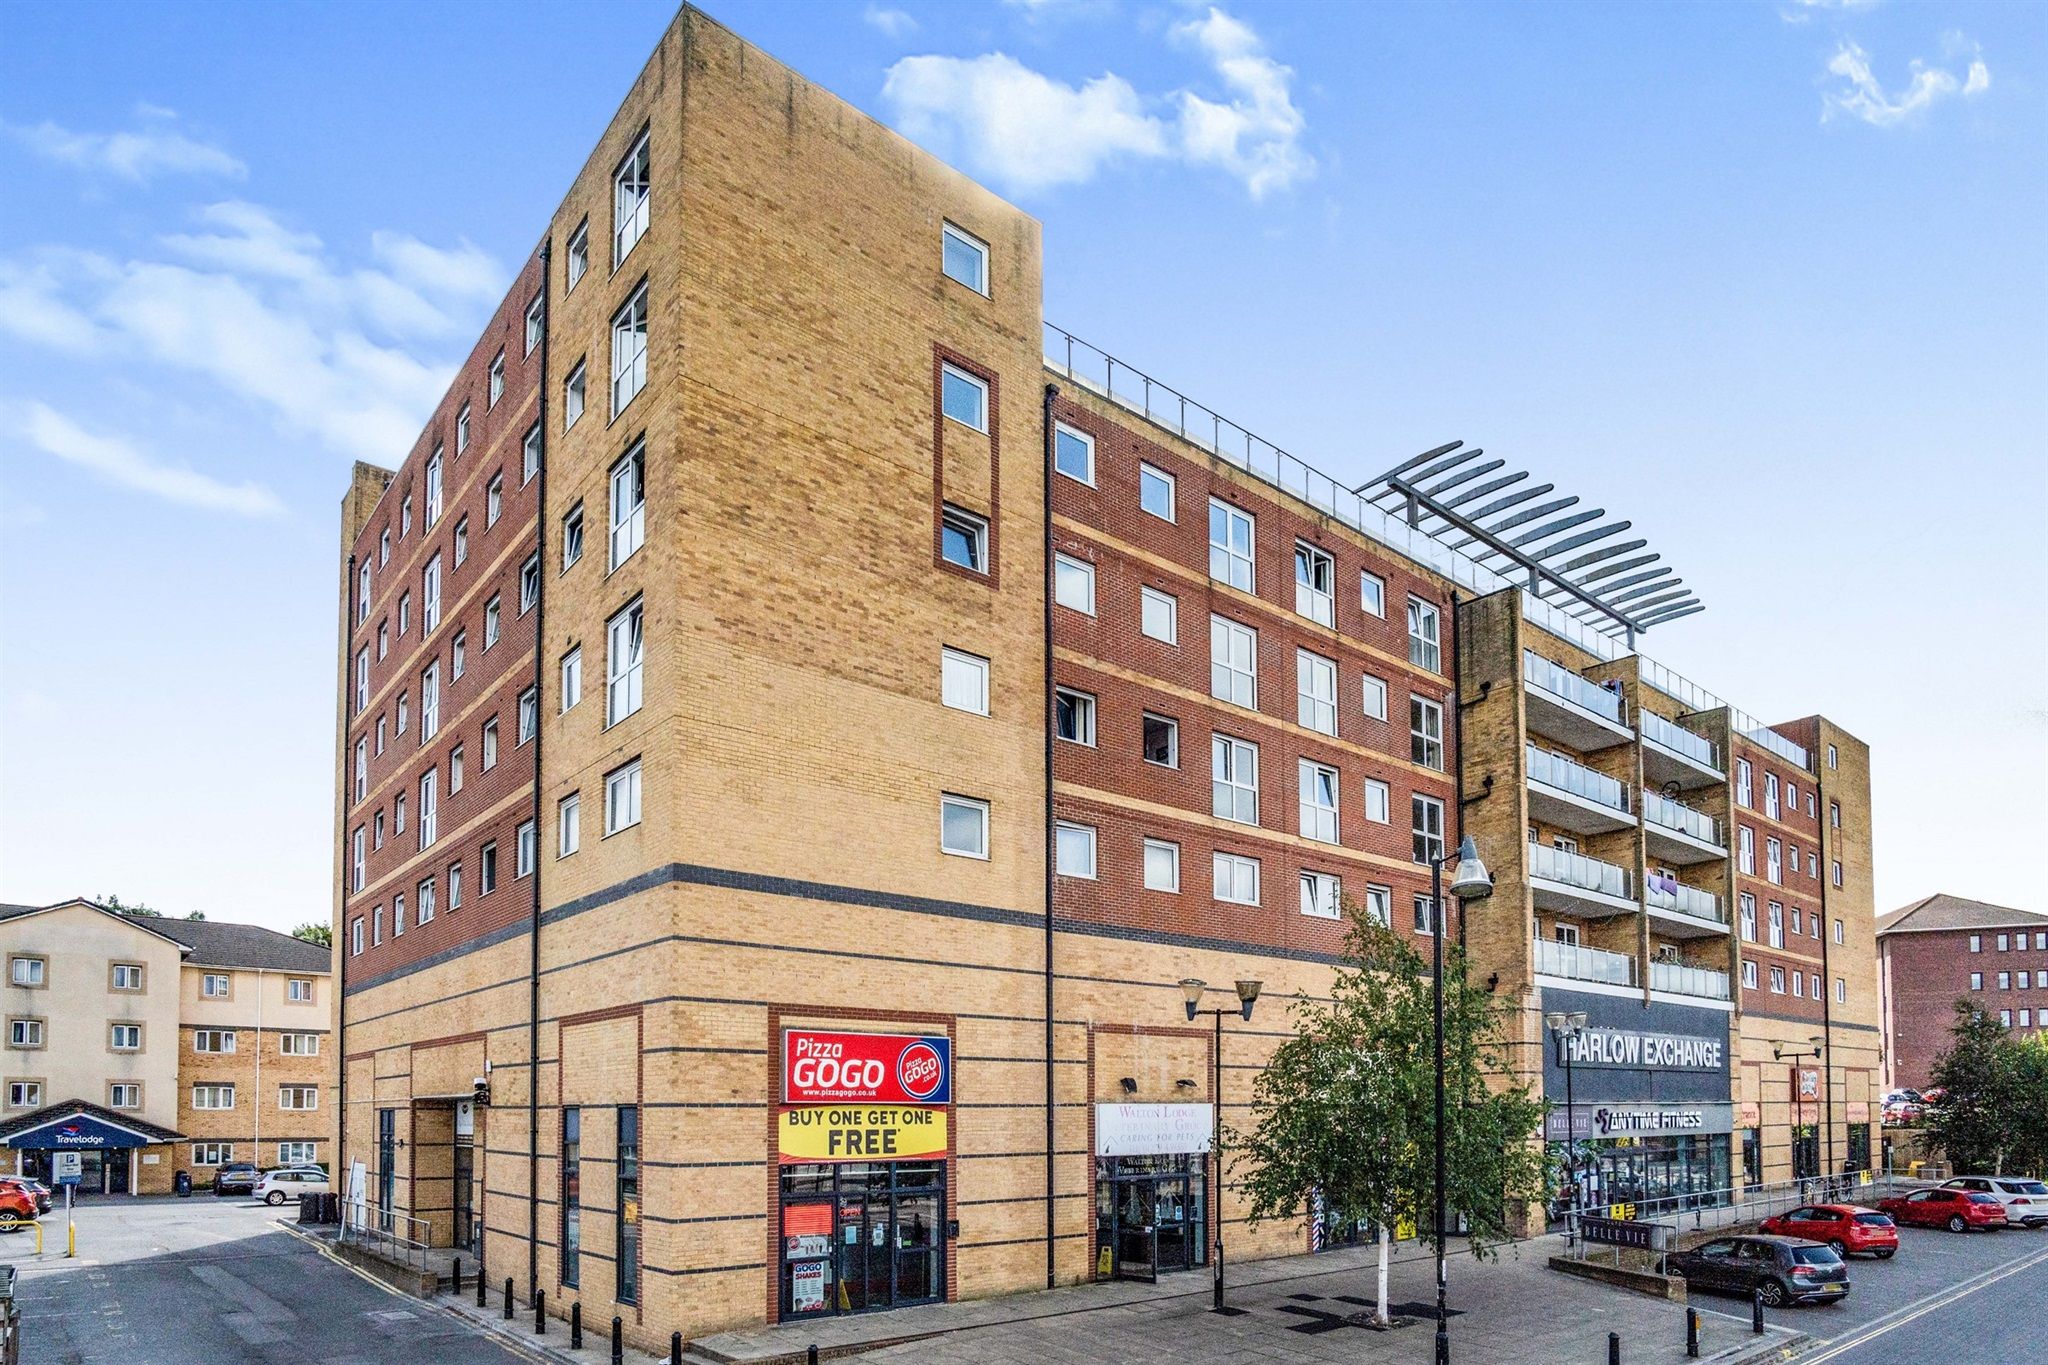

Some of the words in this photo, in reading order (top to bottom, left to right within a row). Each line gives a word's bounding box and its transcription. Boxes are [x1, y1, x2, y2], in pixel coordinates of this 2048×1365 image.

[796, 1038, 843, 1058] Pizza
[1562, 1031, 1640, 1064] HARLOW
[1643, 1036, 1722, 1068] EXCHANGE
[904, 1057, 937, 1084] GOGO
[905, 1057, 923, 1071] Pizza
[793, 1058, 885, 1089] GOGO
[802, 1088, 877, 1098] www.pizzagogo.co.uk
[789, 1110, 824, 1126] BUY
[828, 1110, 863, 1126] ONE
[867, 1110, 898, 1125] GET
[902, 1110, 933, 1125] ONE
[1553, 1118, 1574, 1129] BELL
[1610, 1112, 1659, 1130] ANYTIME
[1661, 1111, 1703, 1128] FITNESS
[56, 1135, 105, 1145] Travelodge
[840, 1207, 862, 1217] OPEN
[1585, 1225, 1620, 1241] BELLE
[1626, 1230, 1646, 1245] VIE
[795, 1263, 822, 1273] GOGO
[795, 1271, 822, 1280] SHAKES
